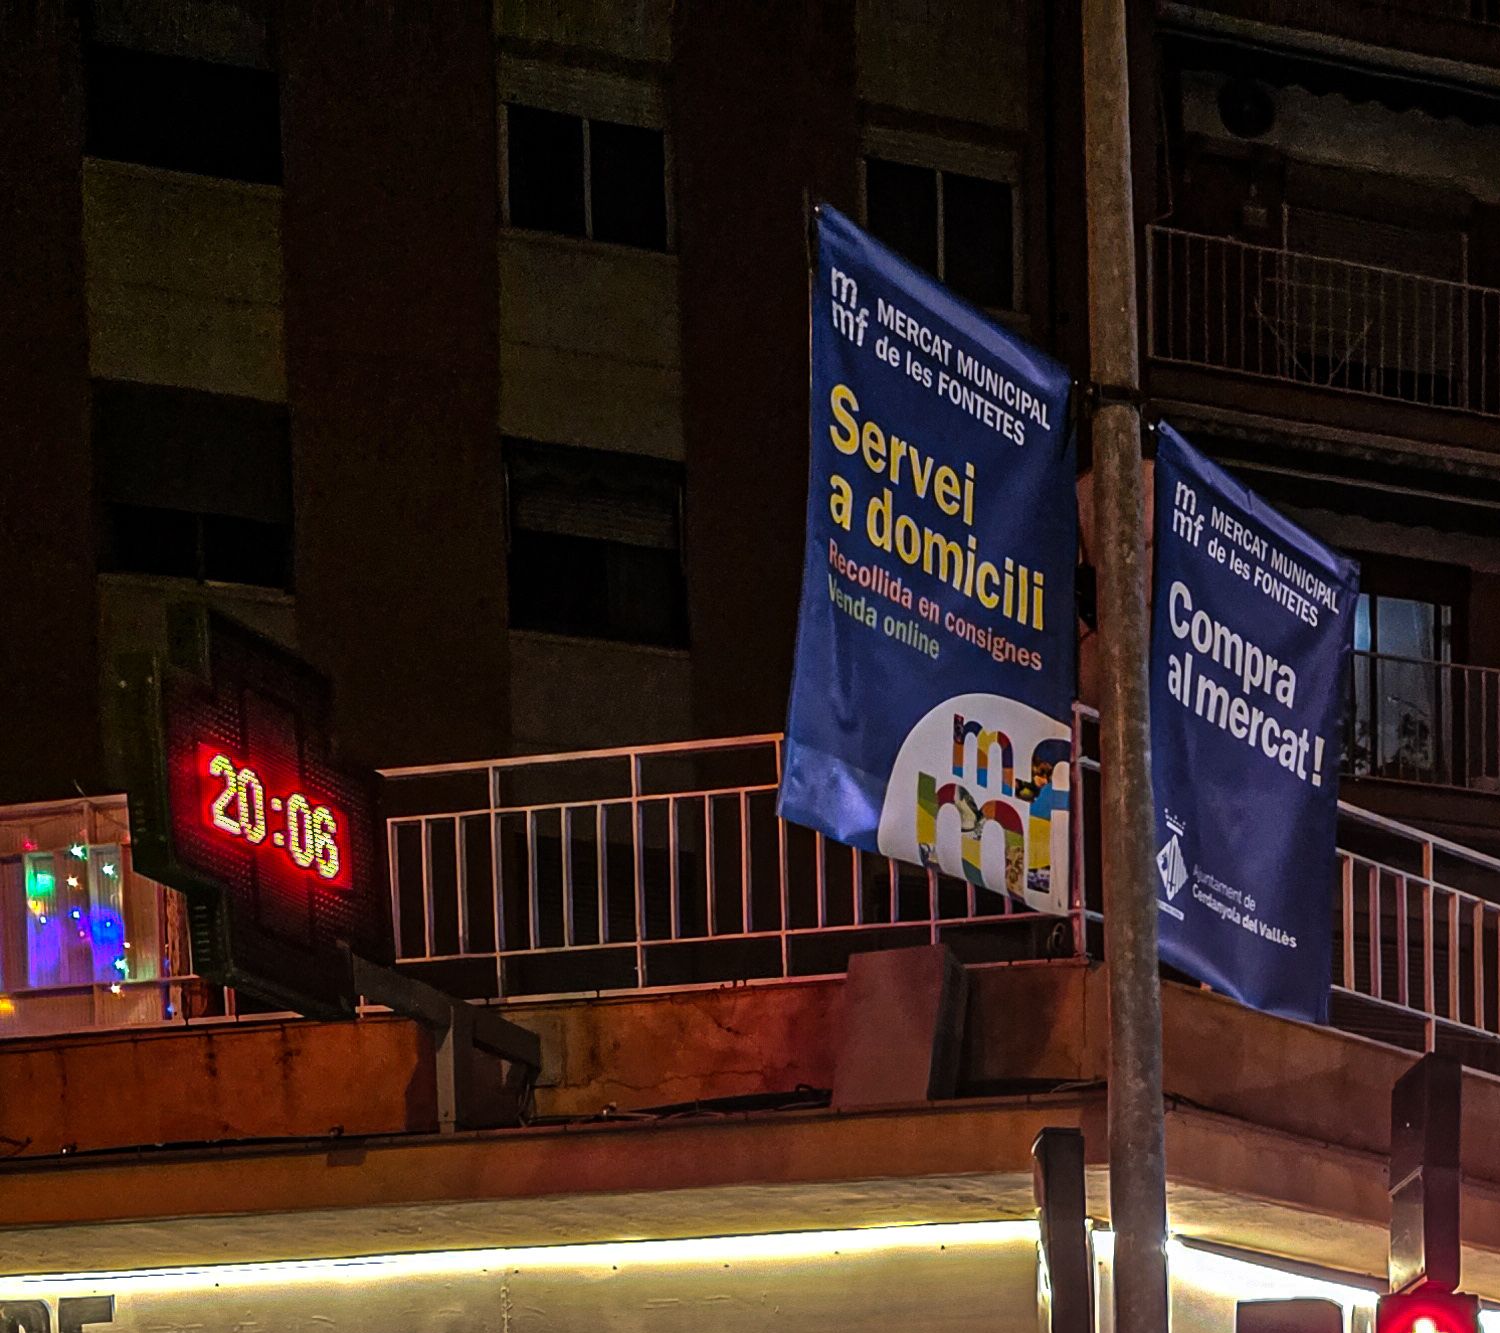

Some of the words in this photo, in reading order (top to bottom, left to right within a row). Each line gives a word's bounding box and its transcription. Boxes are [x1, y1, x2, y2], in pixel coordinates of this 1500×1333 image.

[875, 336, 901, 368] de
[906, 351, 933, 388] les
[938, 371, 1025, 446] FONTETES
[877, 298, 952, 366] MERCAT
[957, 350, 1051, 431] MUNICIPAL
[829, 384, 976, 527] Servei
[828, 537, 913, 610] Recollida
[918, 596, 940, 625] en
[944, 612, 1043, 671] consignes
[828, 573, 878, 630] Venda
[883, 615, 940, 660] online
[829, 477, 854, 534] a
[866, 489, 1045, 631] domicili
[1207, 537, 1226, 564] de
[1229, 549, 1251, 581] les
[1254, 566, 1318, 627] FONTETES
[1211, 506, 1269, 562] MERCAT
[1271, 548, 1339, 615] MUNICIPAL
[1168, 580, 1297, 710] Compra
[1167, 652, 1194, 708] al
[1194, 673, 1326, 788] mercat!
[208, 753, 340, 880] 20:06
[1192, 864, 1242, 905] Ajuntament
[1243, 894, 1256, 912] de
[1192, 883, 1241, 925] Cerdanyola
[1241, 915, 1258, 934] del
[1258, 920, 1298, 948] Vallès
